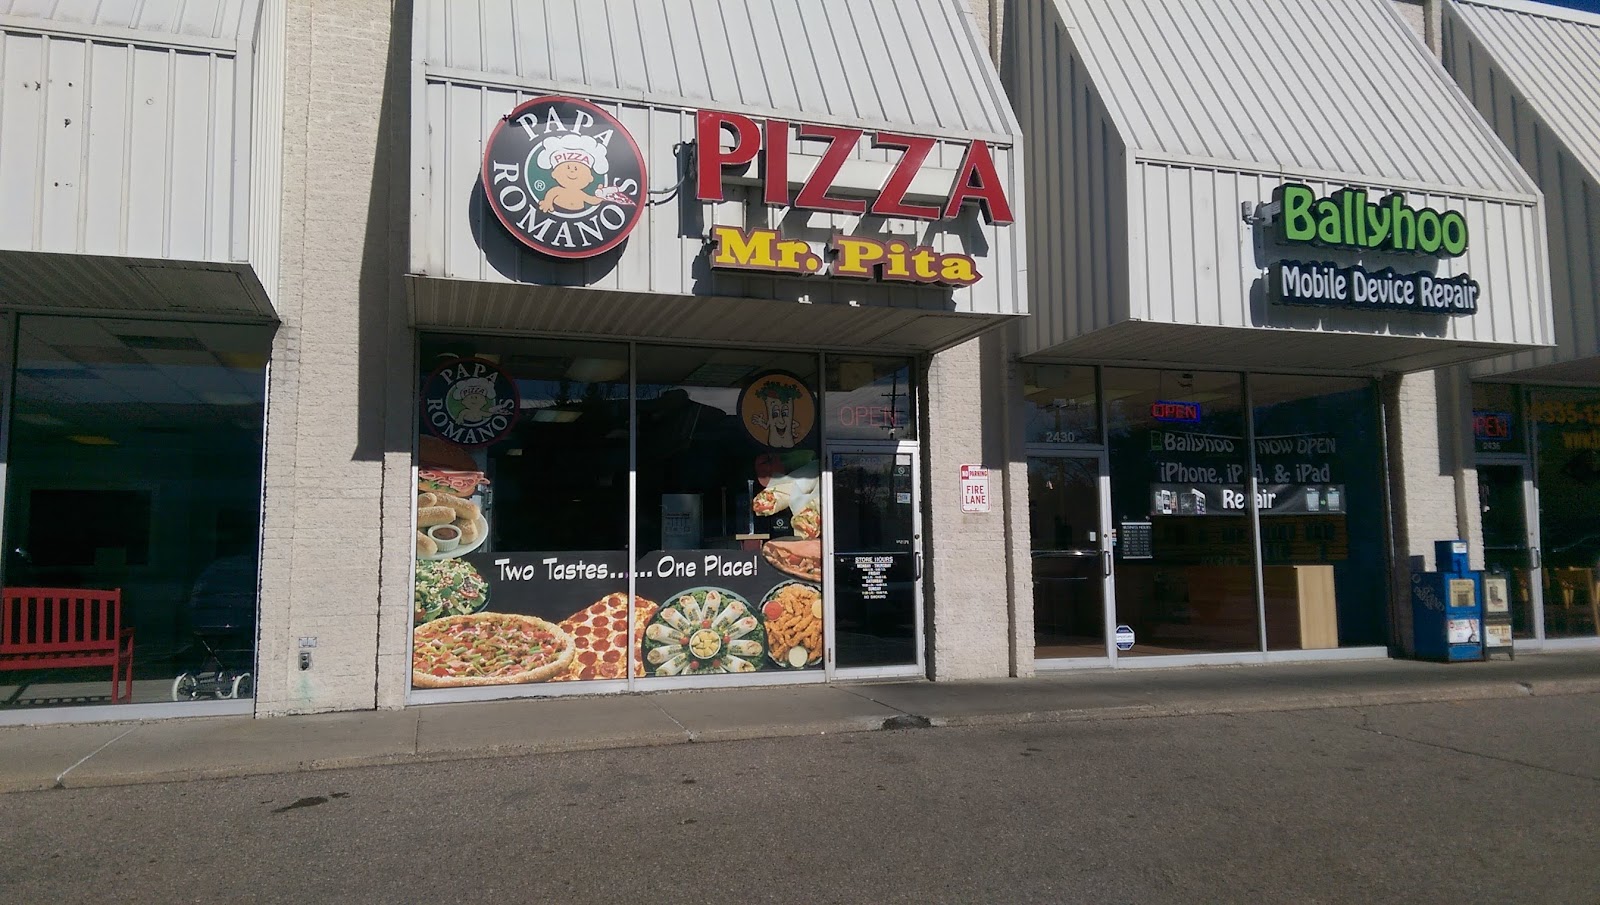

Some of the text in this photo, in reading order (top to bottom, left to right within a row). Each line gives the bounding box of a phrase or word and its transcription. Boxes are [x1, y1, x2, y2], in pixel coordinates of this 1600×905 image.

[516, 106, 613, 147] PAPA
[554, 152, 590, 165] PIZZA
[697, 110, 1014, 226] PIZZA
[494, 160, 638, 248] ROMANOS
[1284, 186, 1467, 254] Ballyhoo
[715, 228, 977, 281] Mr. Pita
[1282, 265, 1477, 309] Mobile Device Repair
[440, 363, 498, 385] PAPA
[427, 398, 515, 443] ROMANOS
[840, 406, 897, 427] OPEN
[1152, 403, 1197, 419] OPEN
[1046, 431, 1075, 443] 2430
[1472, 415, 1508, 438] PEN
[1164, 432, 1235, 453] Ballyhoo
[1258, 437, 1336, 455] NOW OPEN
[1160, 462, 1331, 484] iPhone, iPd, & iPad
[965, 495, 986, 505] LANE
[966, 485, 985, 495] FIRE
[1222, 488, 1277, 509] Reair
[494, 558, 535, 581] Two
[657, 555, 696, 578] One
[704, 555, 758, 577] Place!
